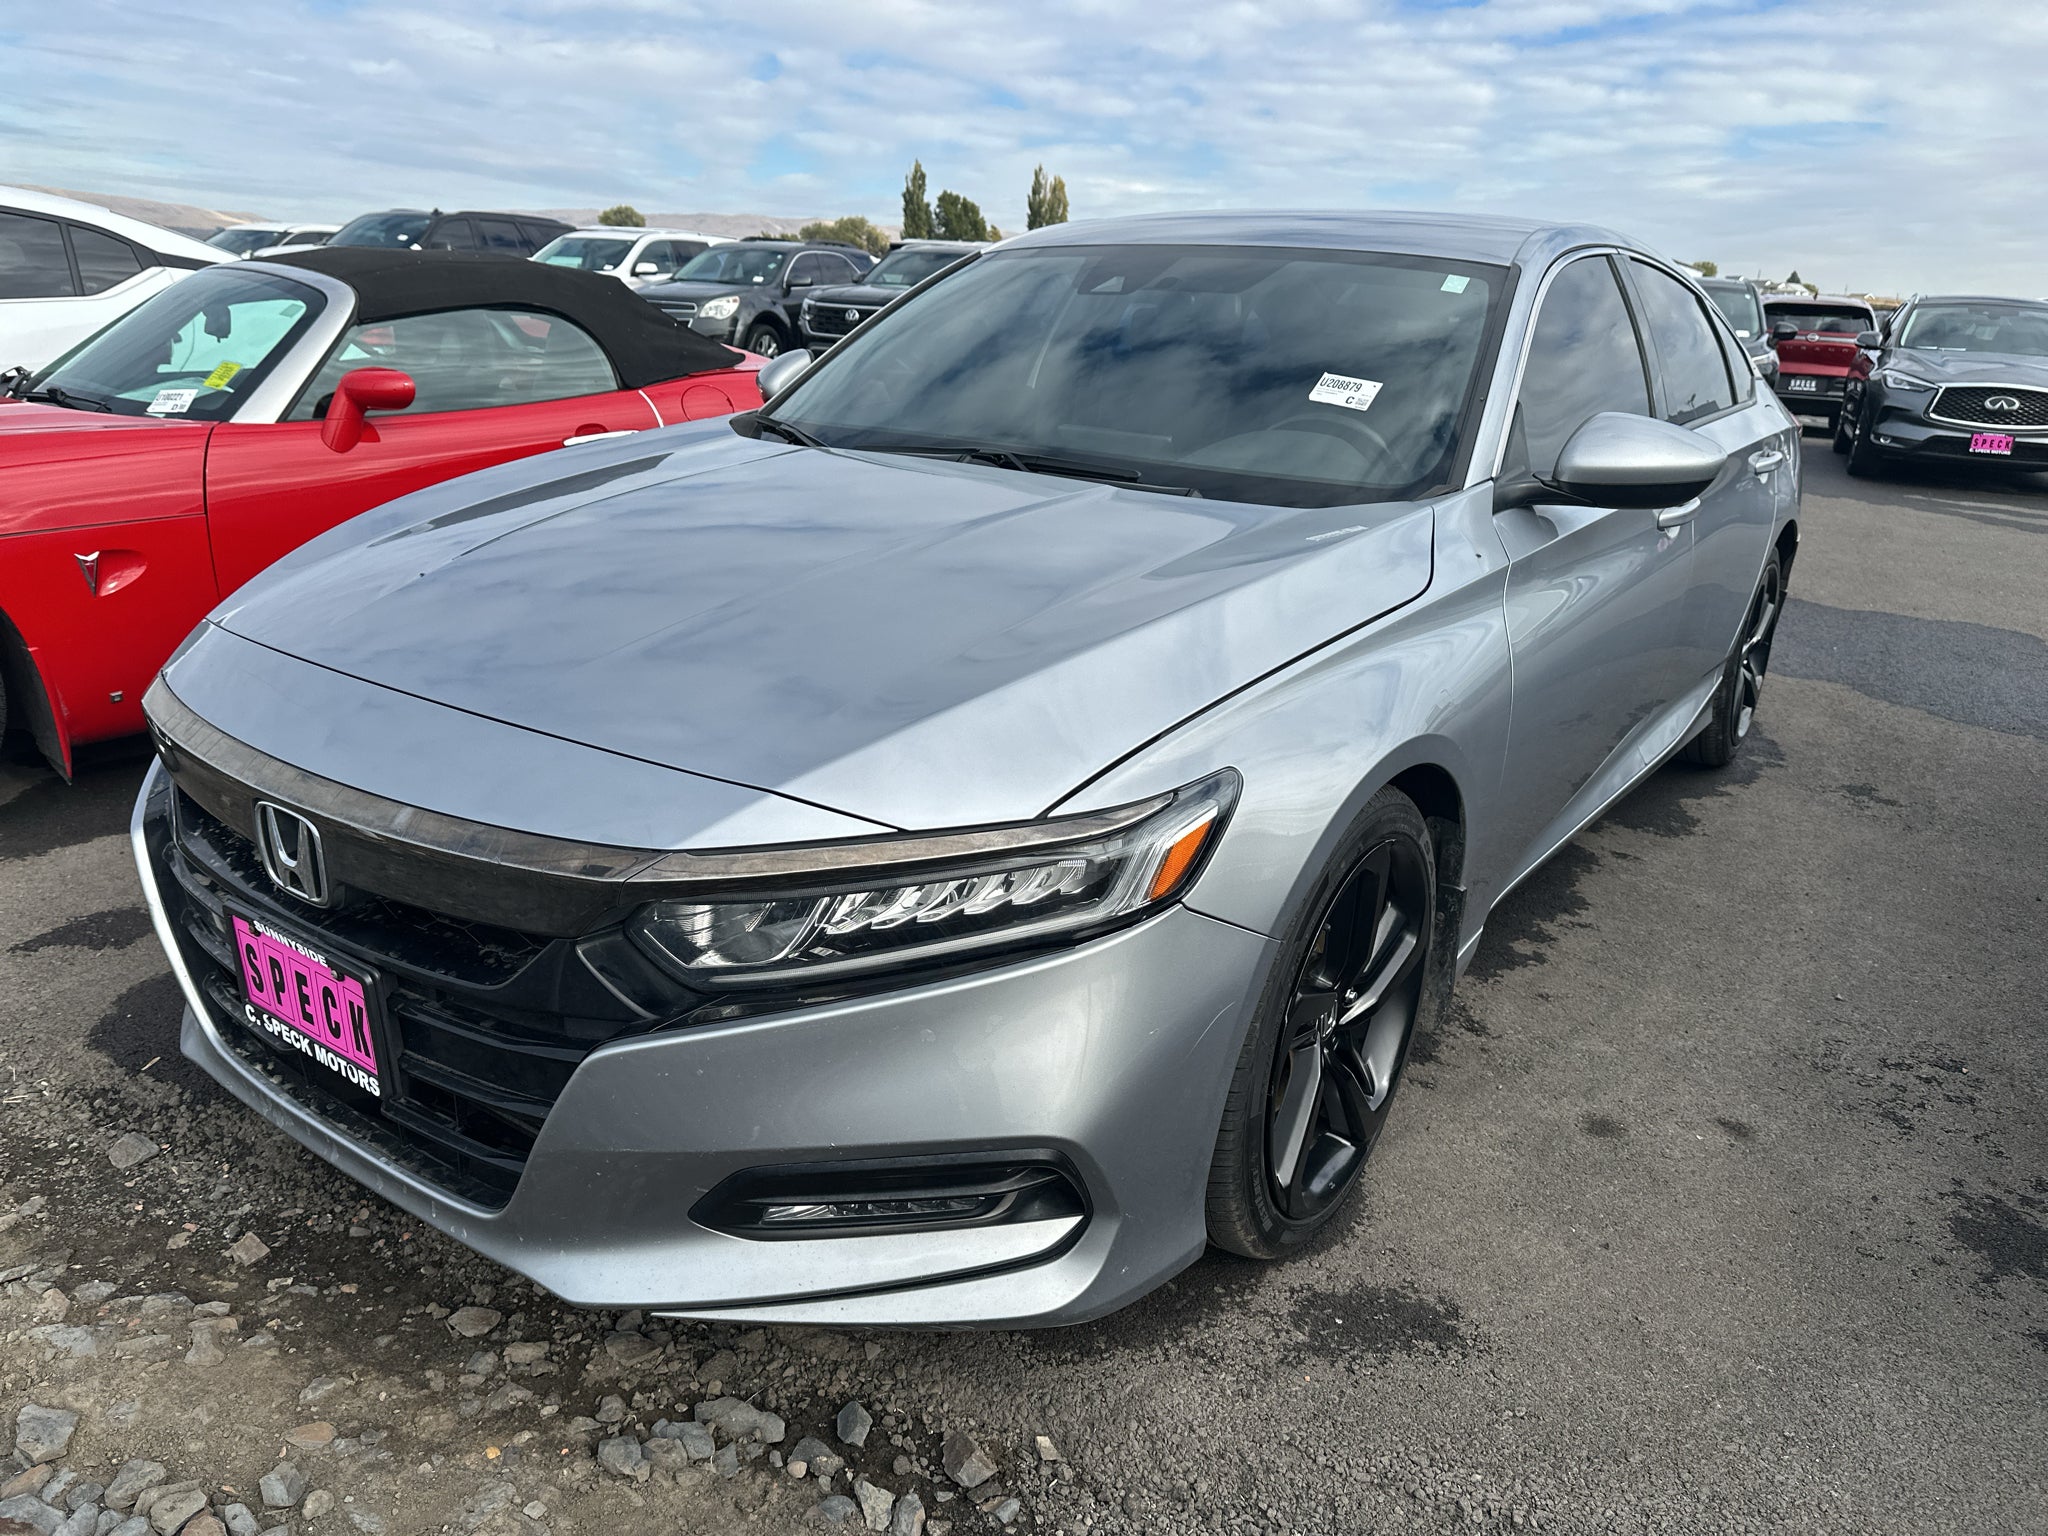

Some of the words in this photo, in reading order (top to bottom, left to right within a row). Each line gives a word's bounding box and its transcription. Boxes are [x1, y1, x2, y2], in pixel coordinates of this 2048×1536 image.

[1319, 377, 1363, 393] U208879
[1345, 395, 1355, 405] C
[1973, 438, 2011, 450] SPECK
[253, 920, 329, 968] SUNNYSIDE
[245, 942, 372, 1059] SPECK
[244, 1004, 262, 1026] C.
[262, 1013, 313, 1058] SPECK
[313, 1042, 381, 1097] MOTORS
